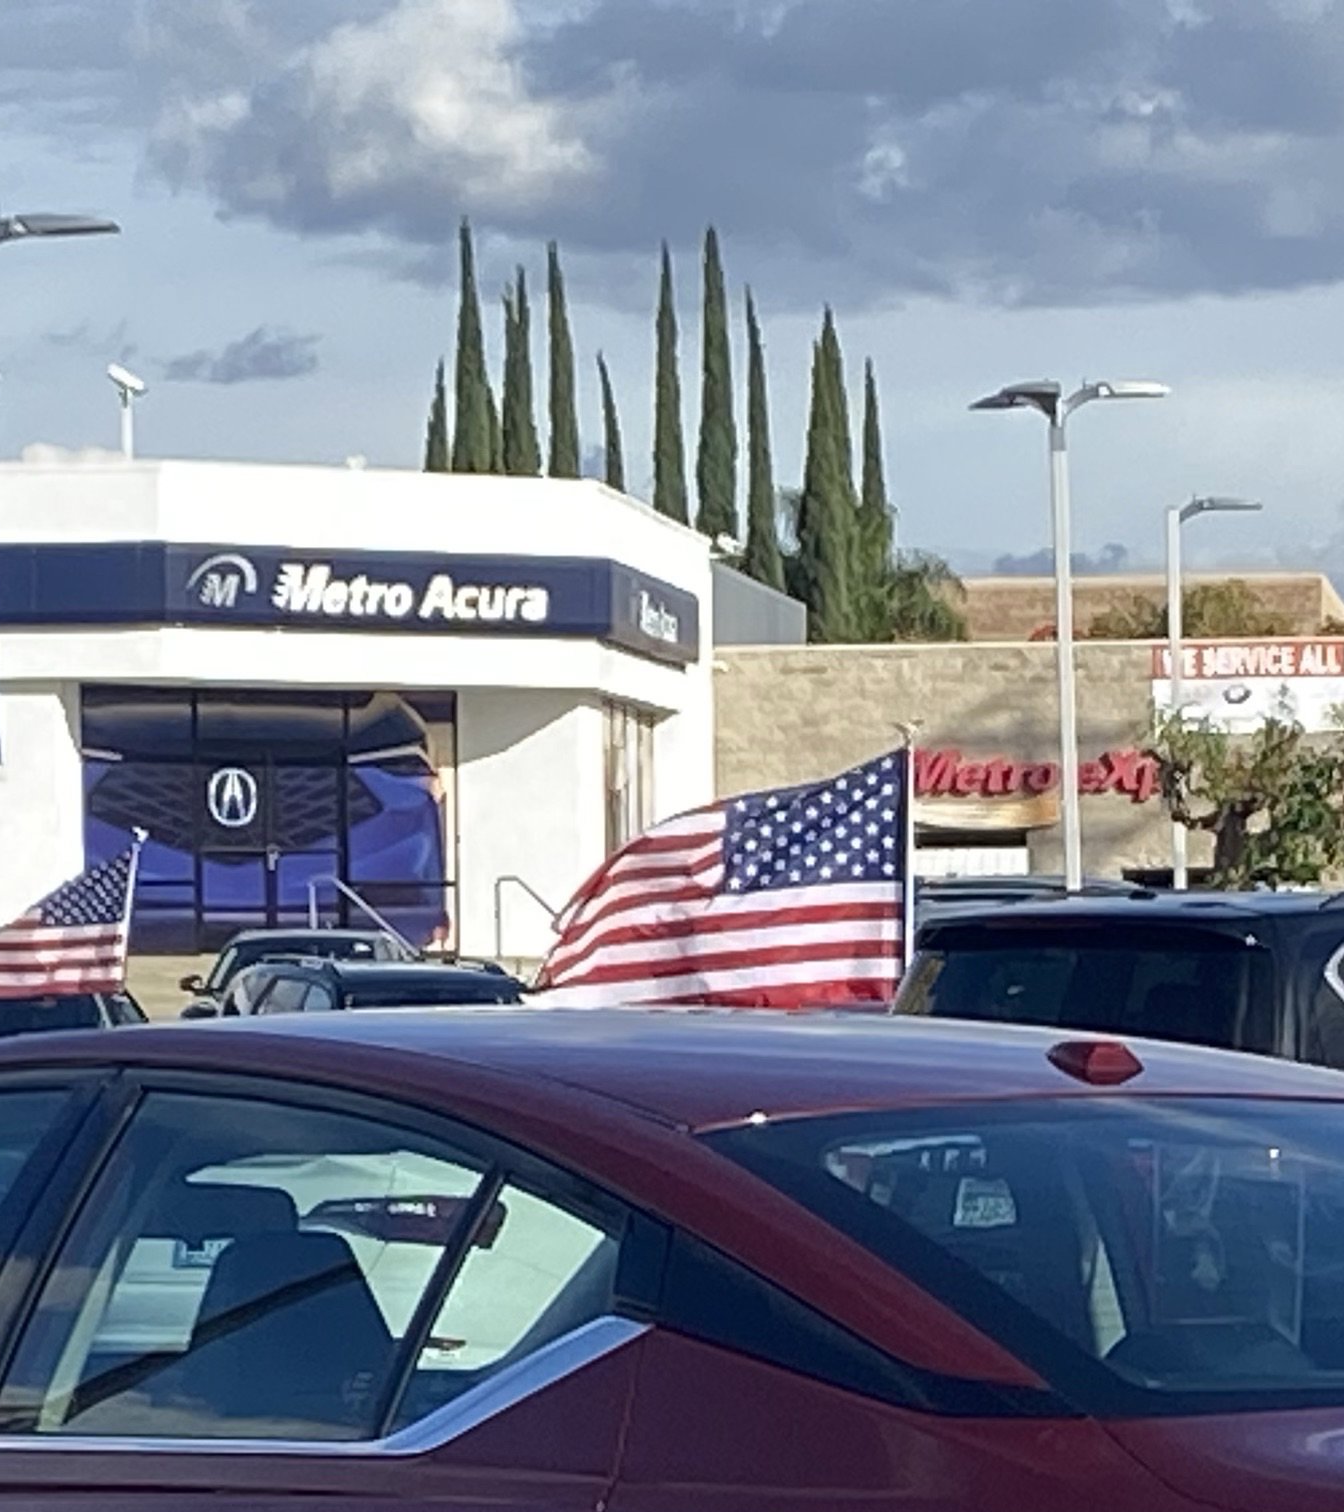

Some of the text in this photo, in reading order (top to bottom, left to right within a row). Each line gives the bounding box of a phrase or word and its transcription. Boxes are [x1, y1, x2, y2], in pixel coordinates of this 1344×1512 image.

[271, 562, 549, 623] Metro Acura
[1201, 646, 1297, 676] SERVICE
[1299, 644, 1342, 675] ALL
